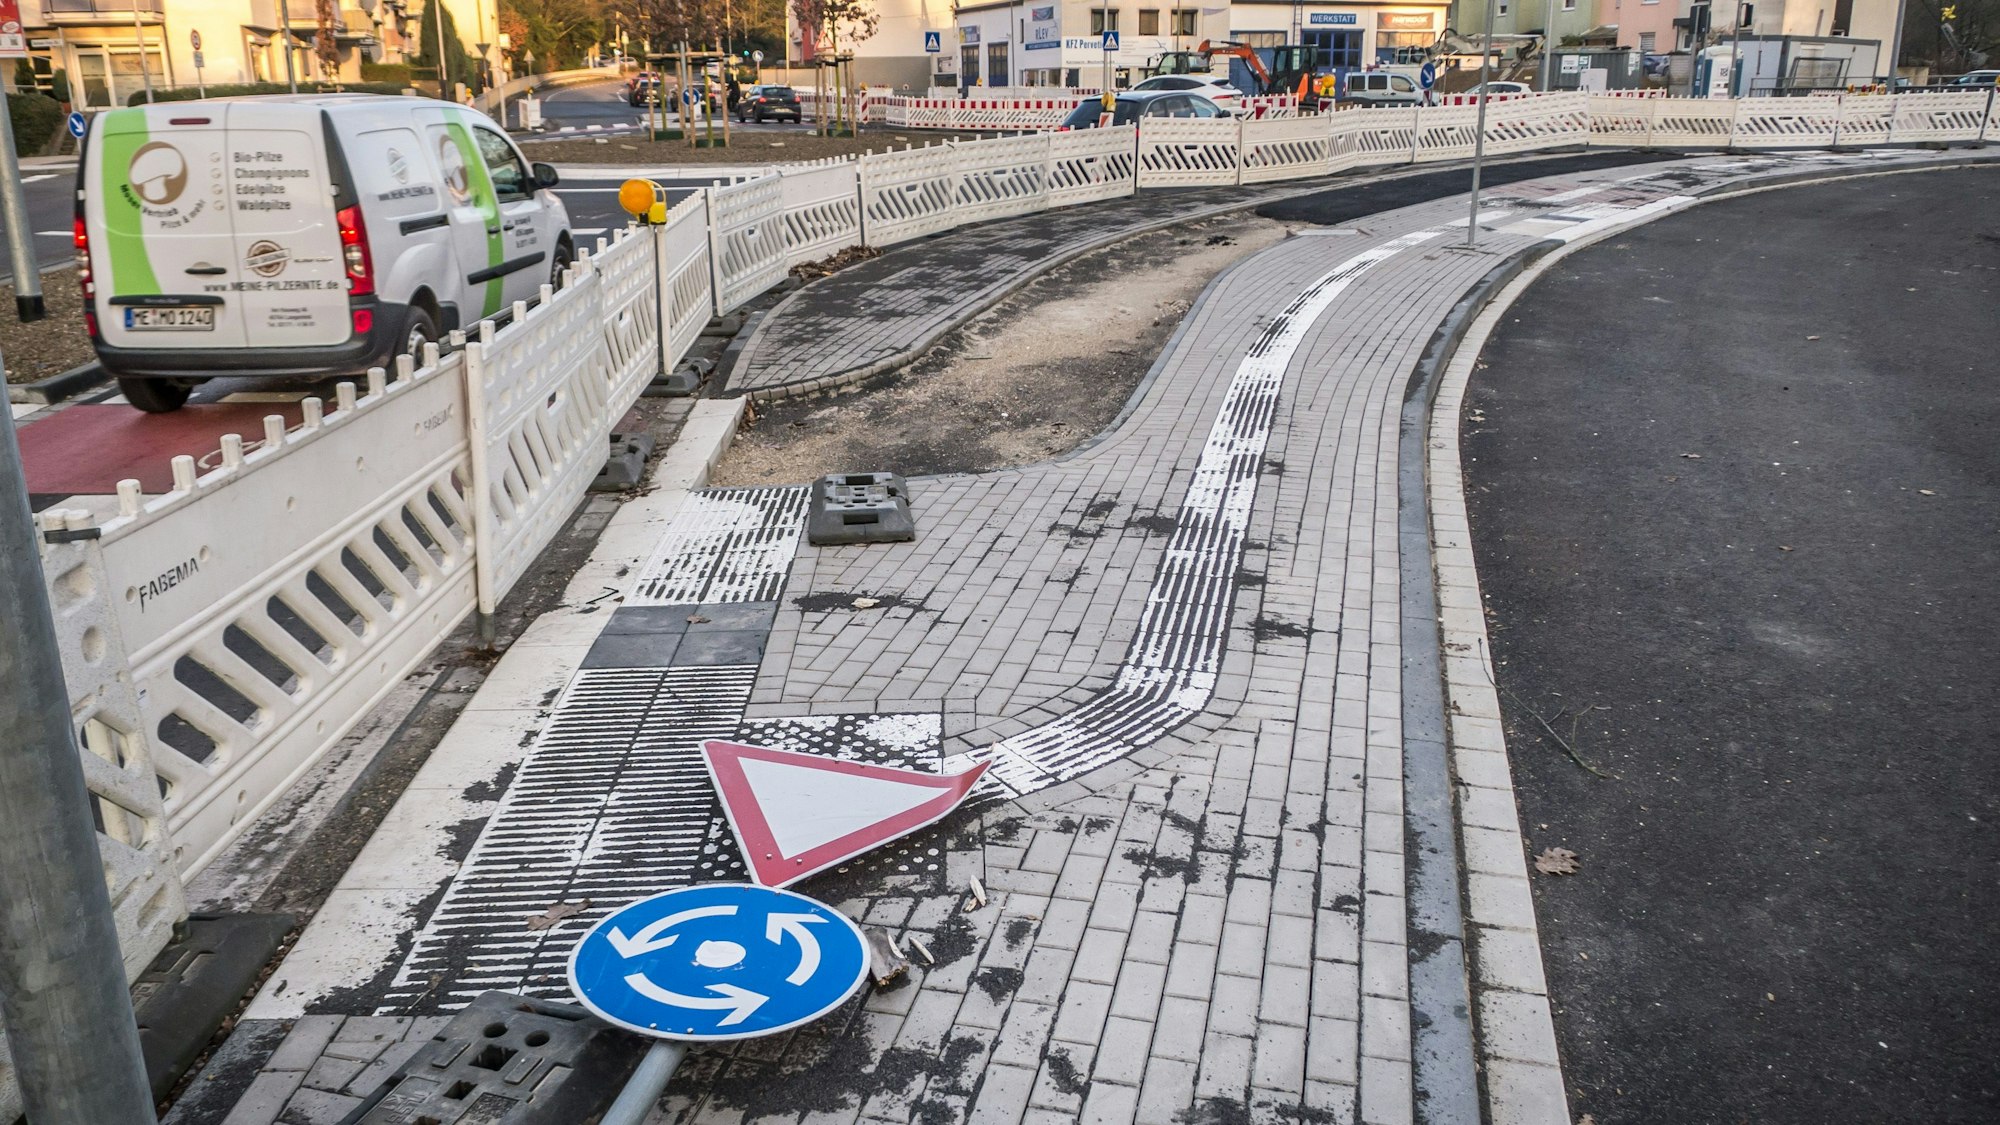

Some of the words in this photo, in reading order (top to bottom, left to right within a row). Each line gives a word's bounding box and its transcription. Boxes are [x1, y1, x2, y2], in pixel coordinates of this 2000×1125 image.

[1311, 15, 1356, 23] WERKSTATT
[1066, 39, 1077, 48] KFZ
[1080, 40, 1103, 48] Perveti
[234, 152, 282, 162] Bio-Pilze
[235, 168, 309, 180] Champignons
[236, 184, 285, 196] Edelpilze
[238, 199, 291, 212] Waldpilze
[133, 310, 150, 325] ME
[160, 310, 176, 325] MO
[179, 310, 212, 325] 1240
[139, 557, 199, 614] FABEMA
